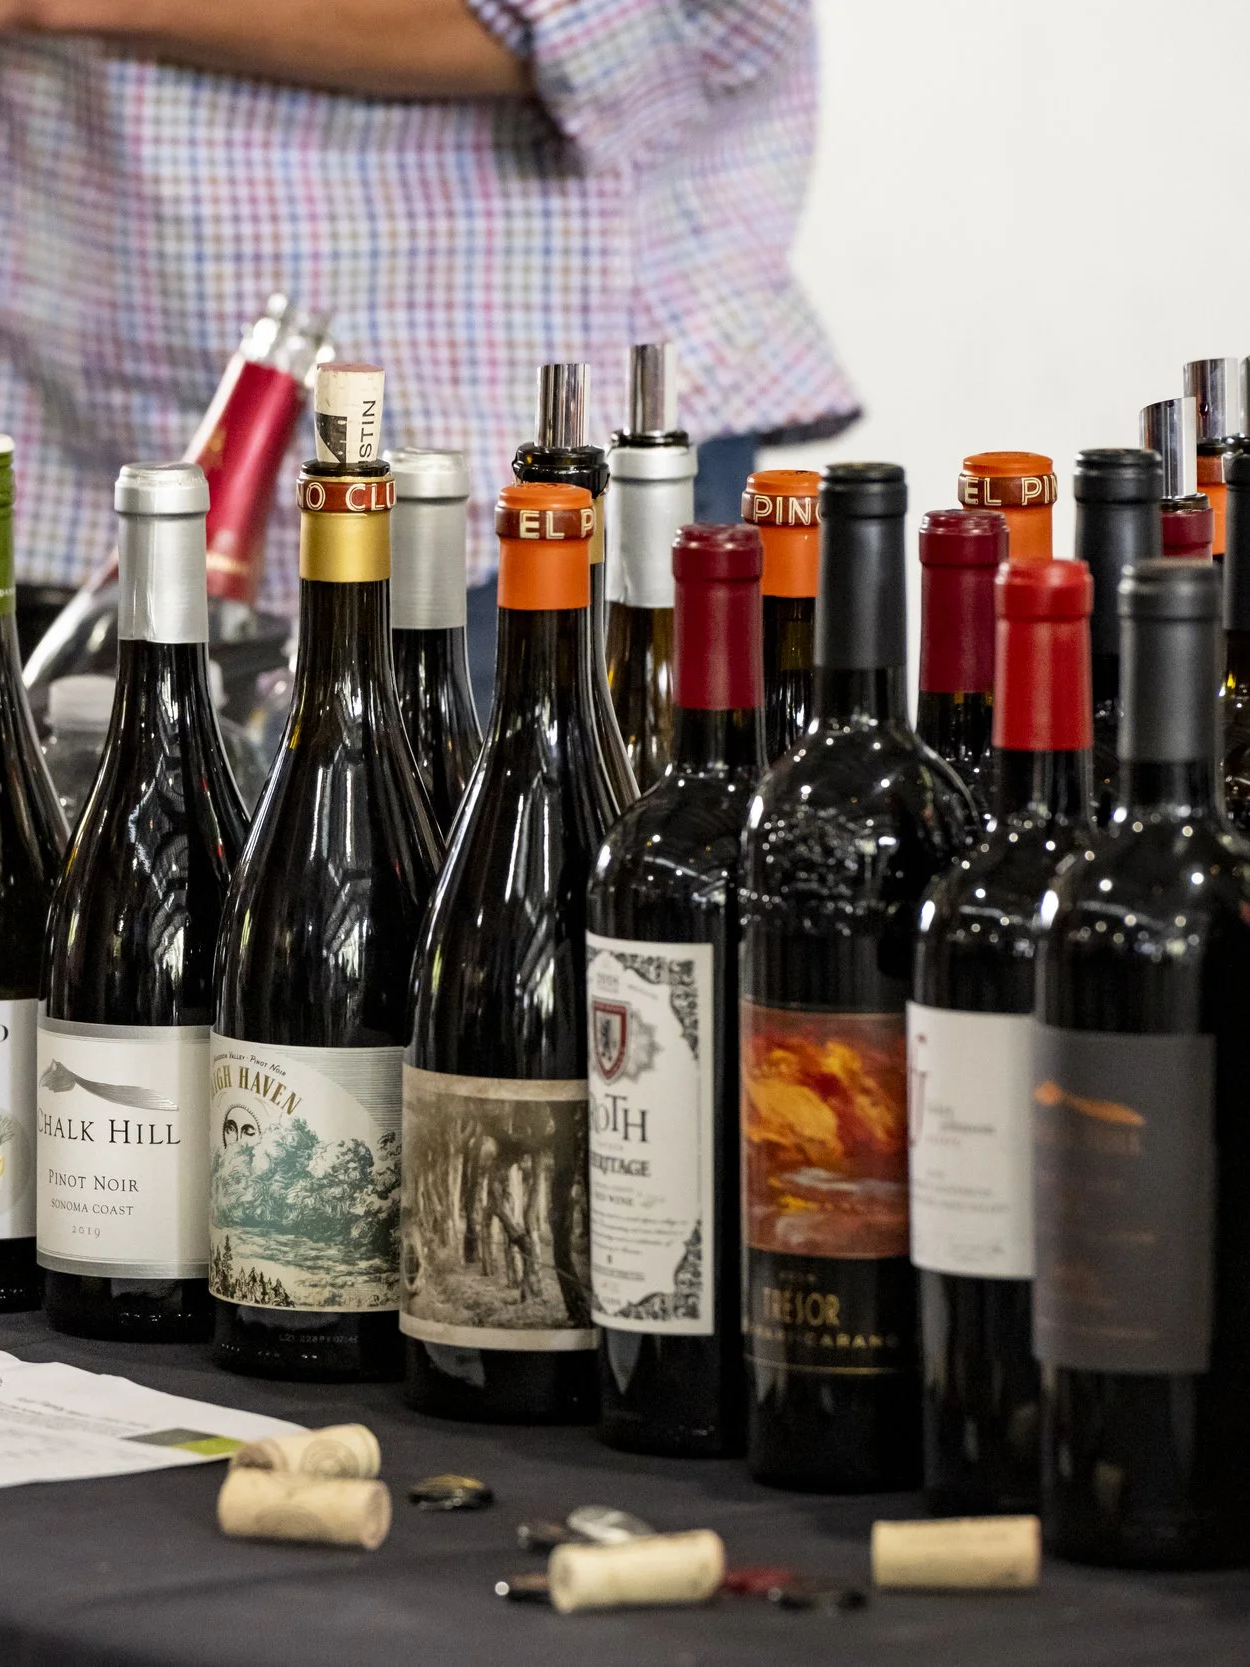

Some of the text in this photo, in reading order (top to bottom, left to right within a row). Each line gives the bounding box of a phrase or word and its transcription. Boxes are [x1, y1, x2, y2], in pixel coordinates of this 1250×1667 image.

[358, 400, 376, 464] STIN
[964, 476, 1001, 506] EL
[520, 509, 565, 540] EL
[753, 494, 822, 526] PIN
[211, 1064, 303, 1116] IGH HAVEN
[38, 1108, 182, 1145] CHALK HILL
[48, 1168, 140, 1193] PINOT NOIR
[51, 1198, 135, 1216] SONOMA COAST
[71, 1224, 101, 1239] 2019
